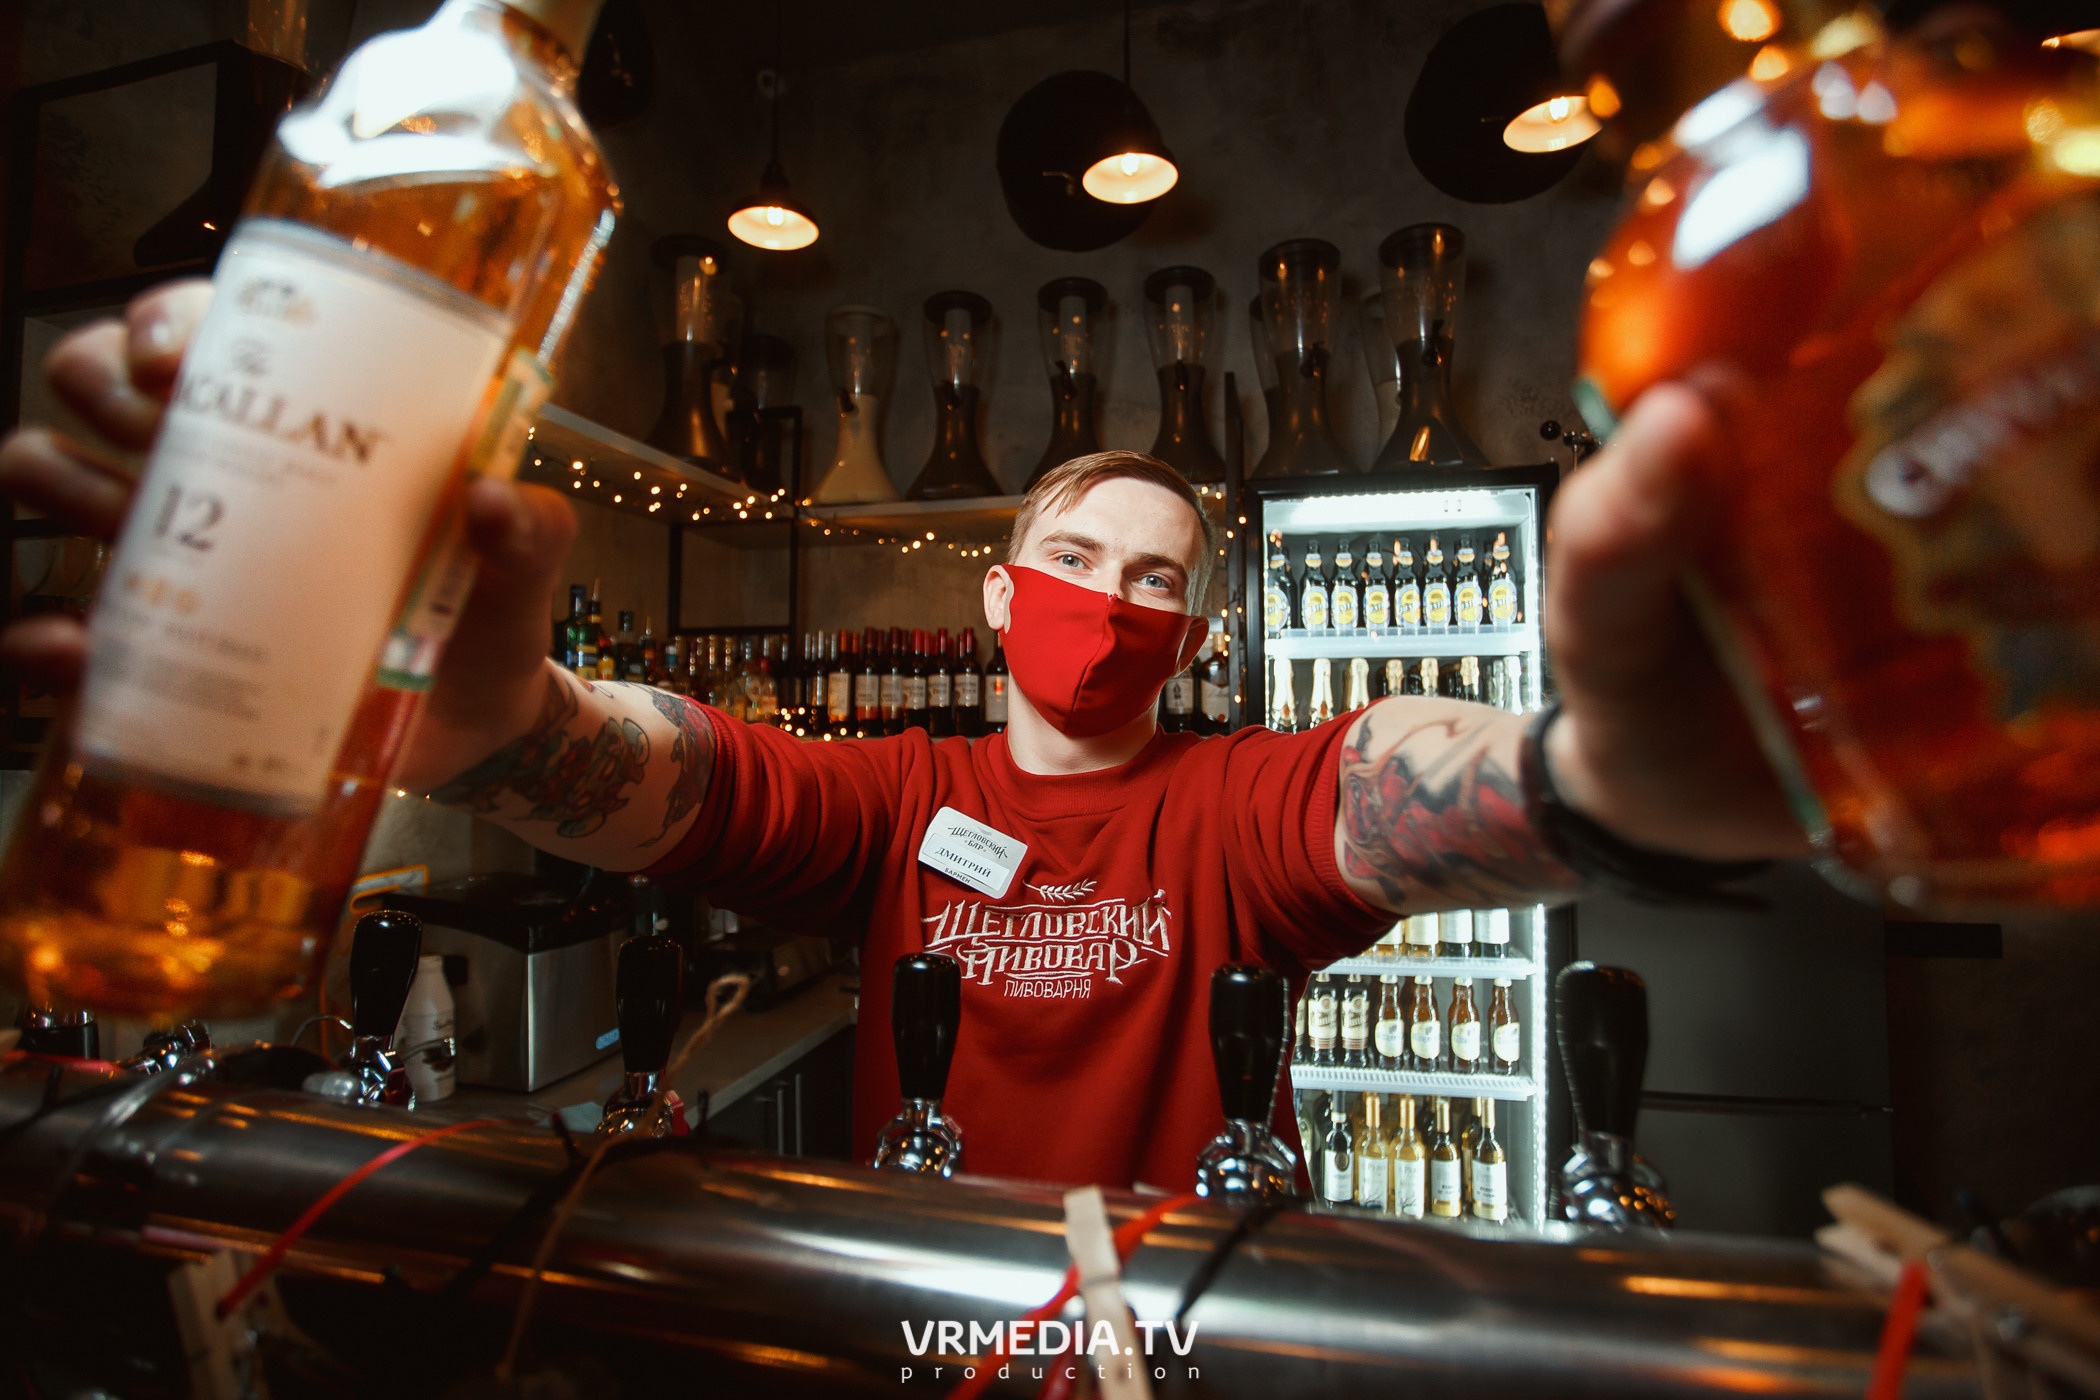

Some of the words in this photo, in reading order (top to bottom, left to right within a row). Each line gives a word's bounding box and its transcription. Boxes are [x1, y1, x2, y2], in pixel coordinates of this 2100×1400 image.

[153, 484, 226, 553] 12
[947, 826, 1008, 859] ЩЕГЛОВСКИЙ
[934, 846, 992, 878] ДМИТРИЙ
[944, 867, 971, 883] БАРМЕН
[1003, 978, 1092, 999] ПИВОВАРНЯ
